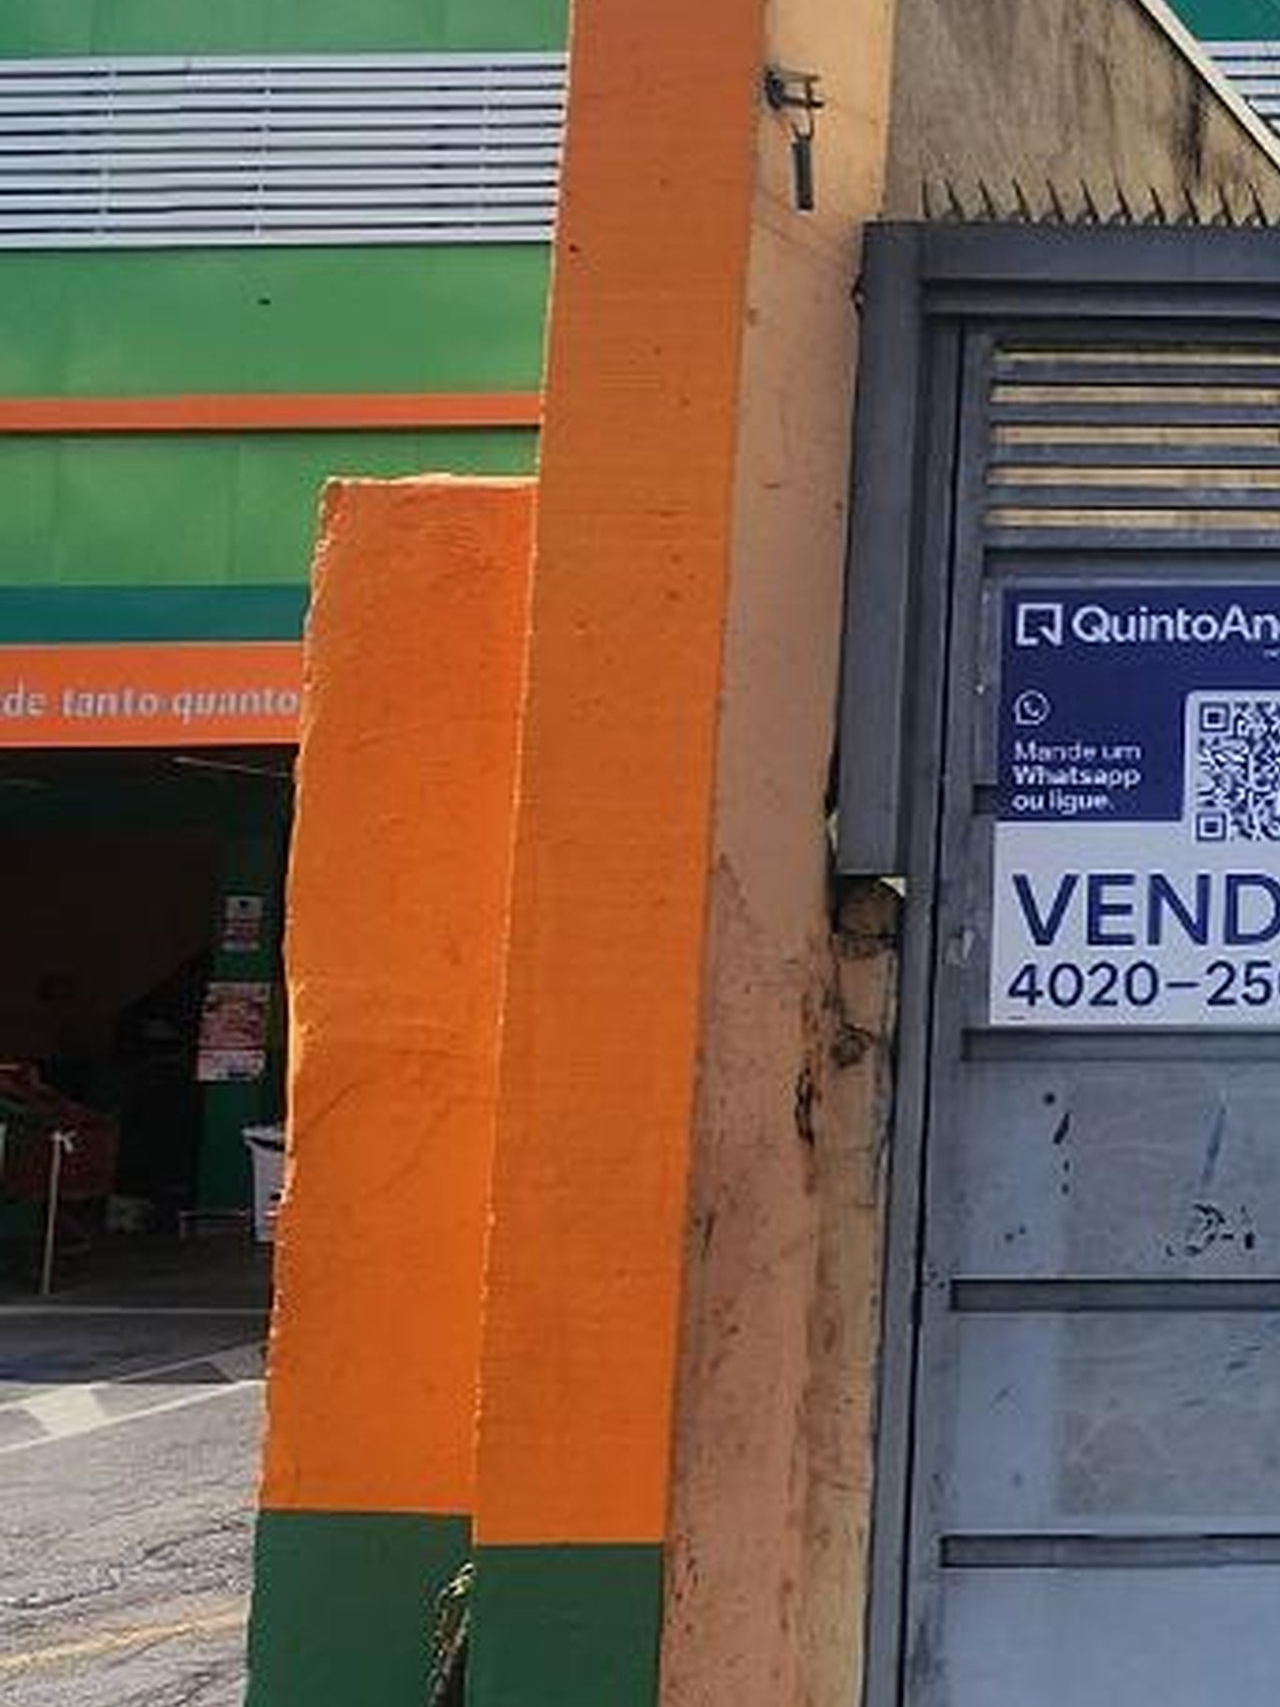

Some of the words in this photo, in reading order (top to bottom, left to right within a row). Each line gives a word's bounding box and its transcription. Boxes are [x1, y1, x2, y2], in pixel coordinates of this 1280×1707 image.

[61, 688, 158, 716] tanto
[172, 688, 299, 725] quanto
[1014, 742, 1096, 761] Mande
[1102, 744, 1142, 760] um
[1012, 765, 1141, 788] Whatsapp
[1012, 793, 1043, 810] ou
